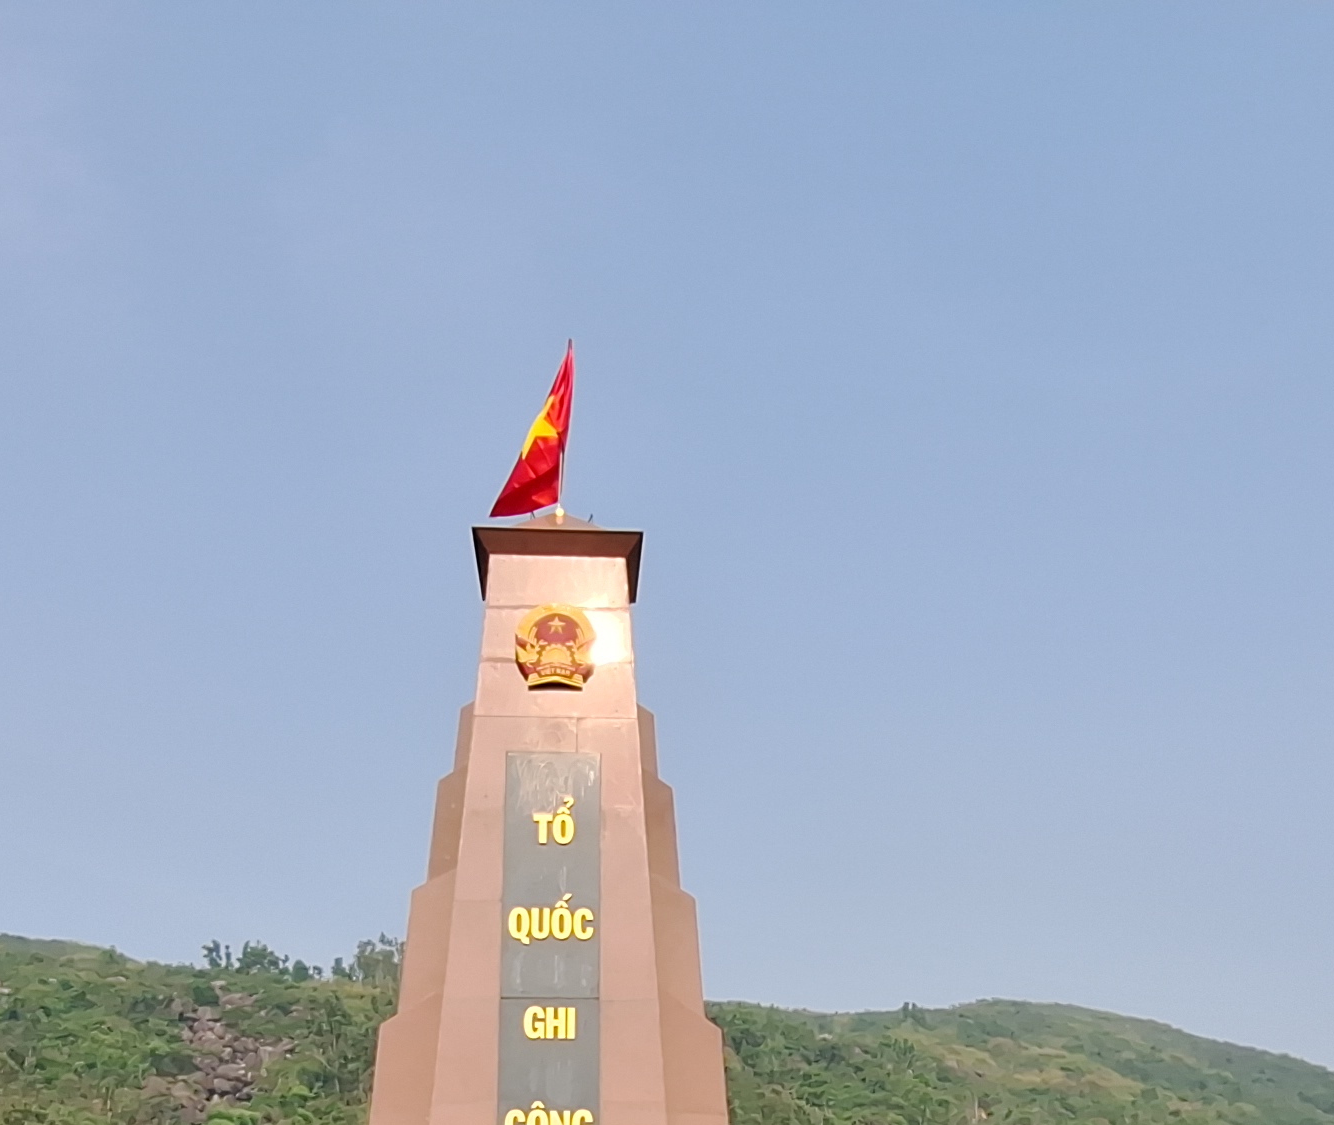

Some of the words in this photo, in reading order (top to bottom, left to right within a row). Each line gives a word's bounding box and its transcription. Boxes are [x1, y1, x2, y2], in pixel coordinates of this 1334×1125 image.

[532, 796, 575, 846] TỔ
[508, 893, 594, 945] QUỐC
[523, 1005, 576, 1040] GHI
